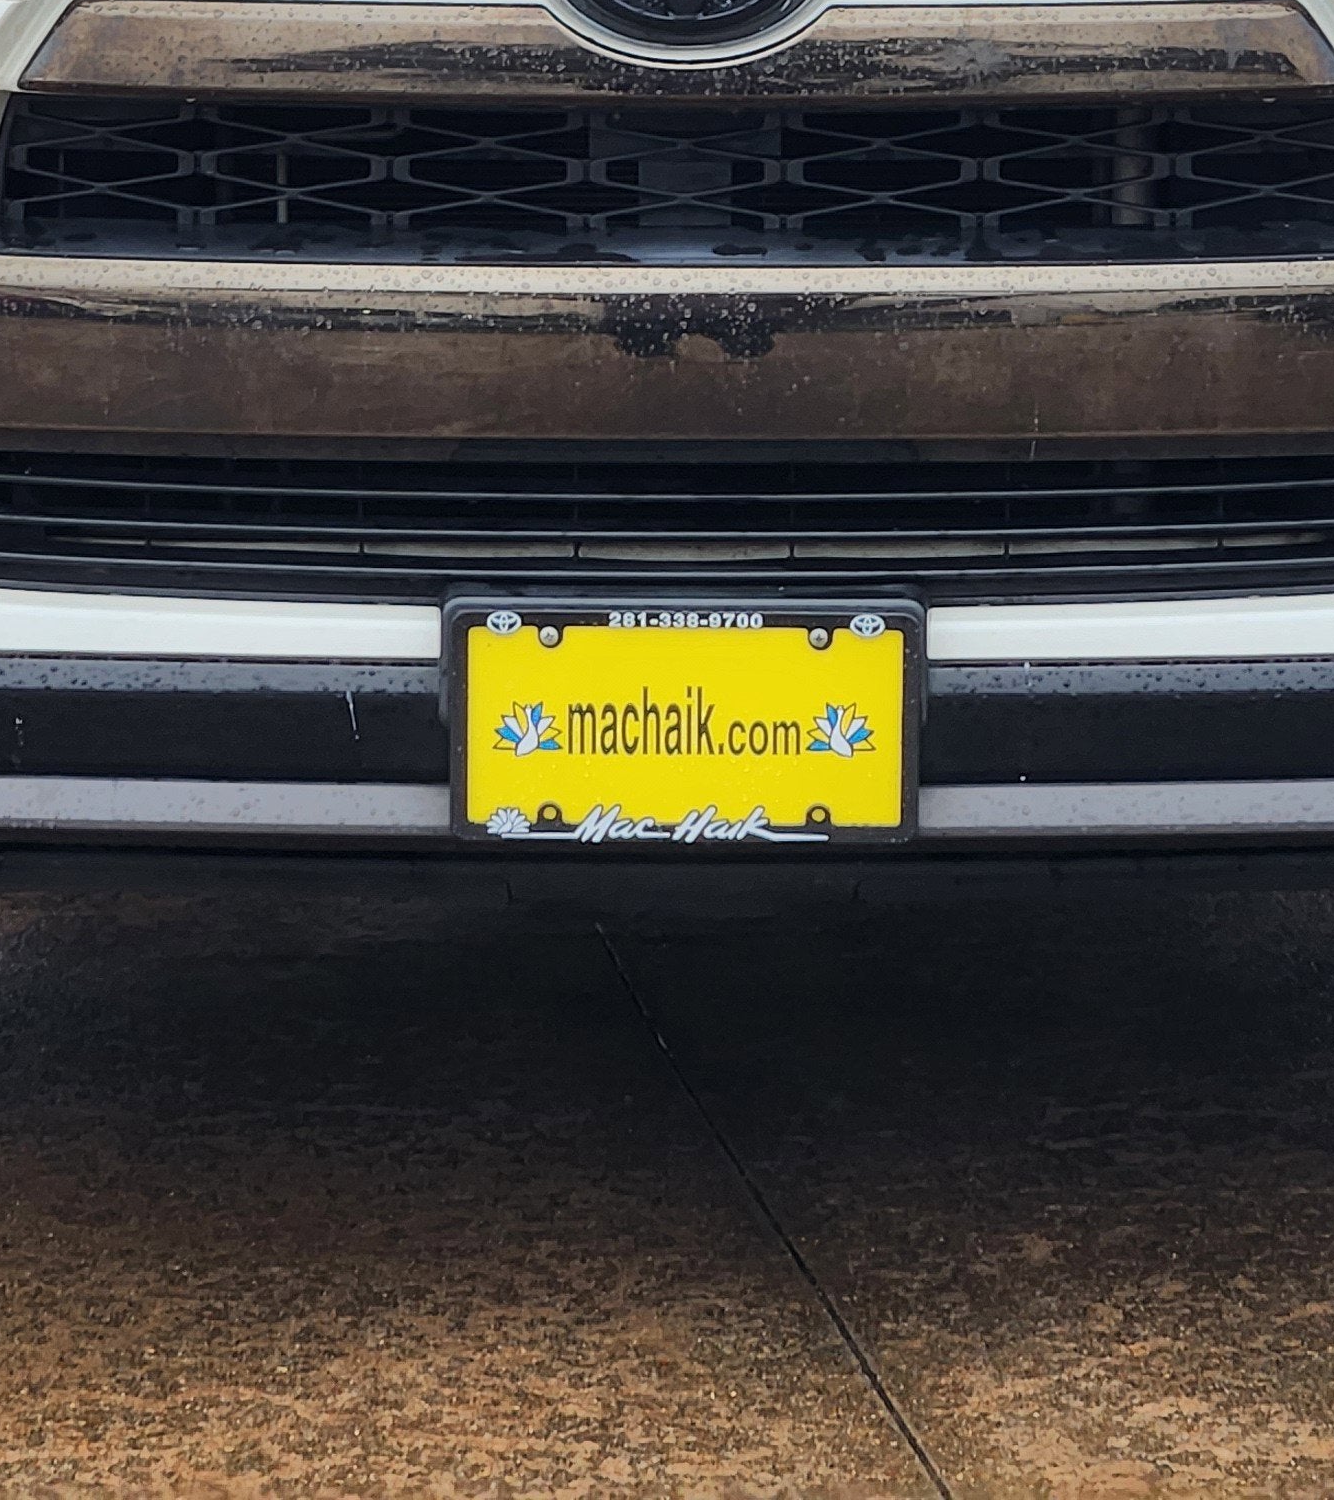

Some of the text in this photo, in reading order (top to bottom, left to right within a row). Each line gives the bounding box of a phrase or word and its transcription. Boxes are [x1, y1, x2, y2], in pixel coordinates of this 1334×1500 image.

[608, 611, 764, 629] 281-338-9700
[566, 686, 802, 756] machaik.com
[573, 804, 670, 844] Mac
